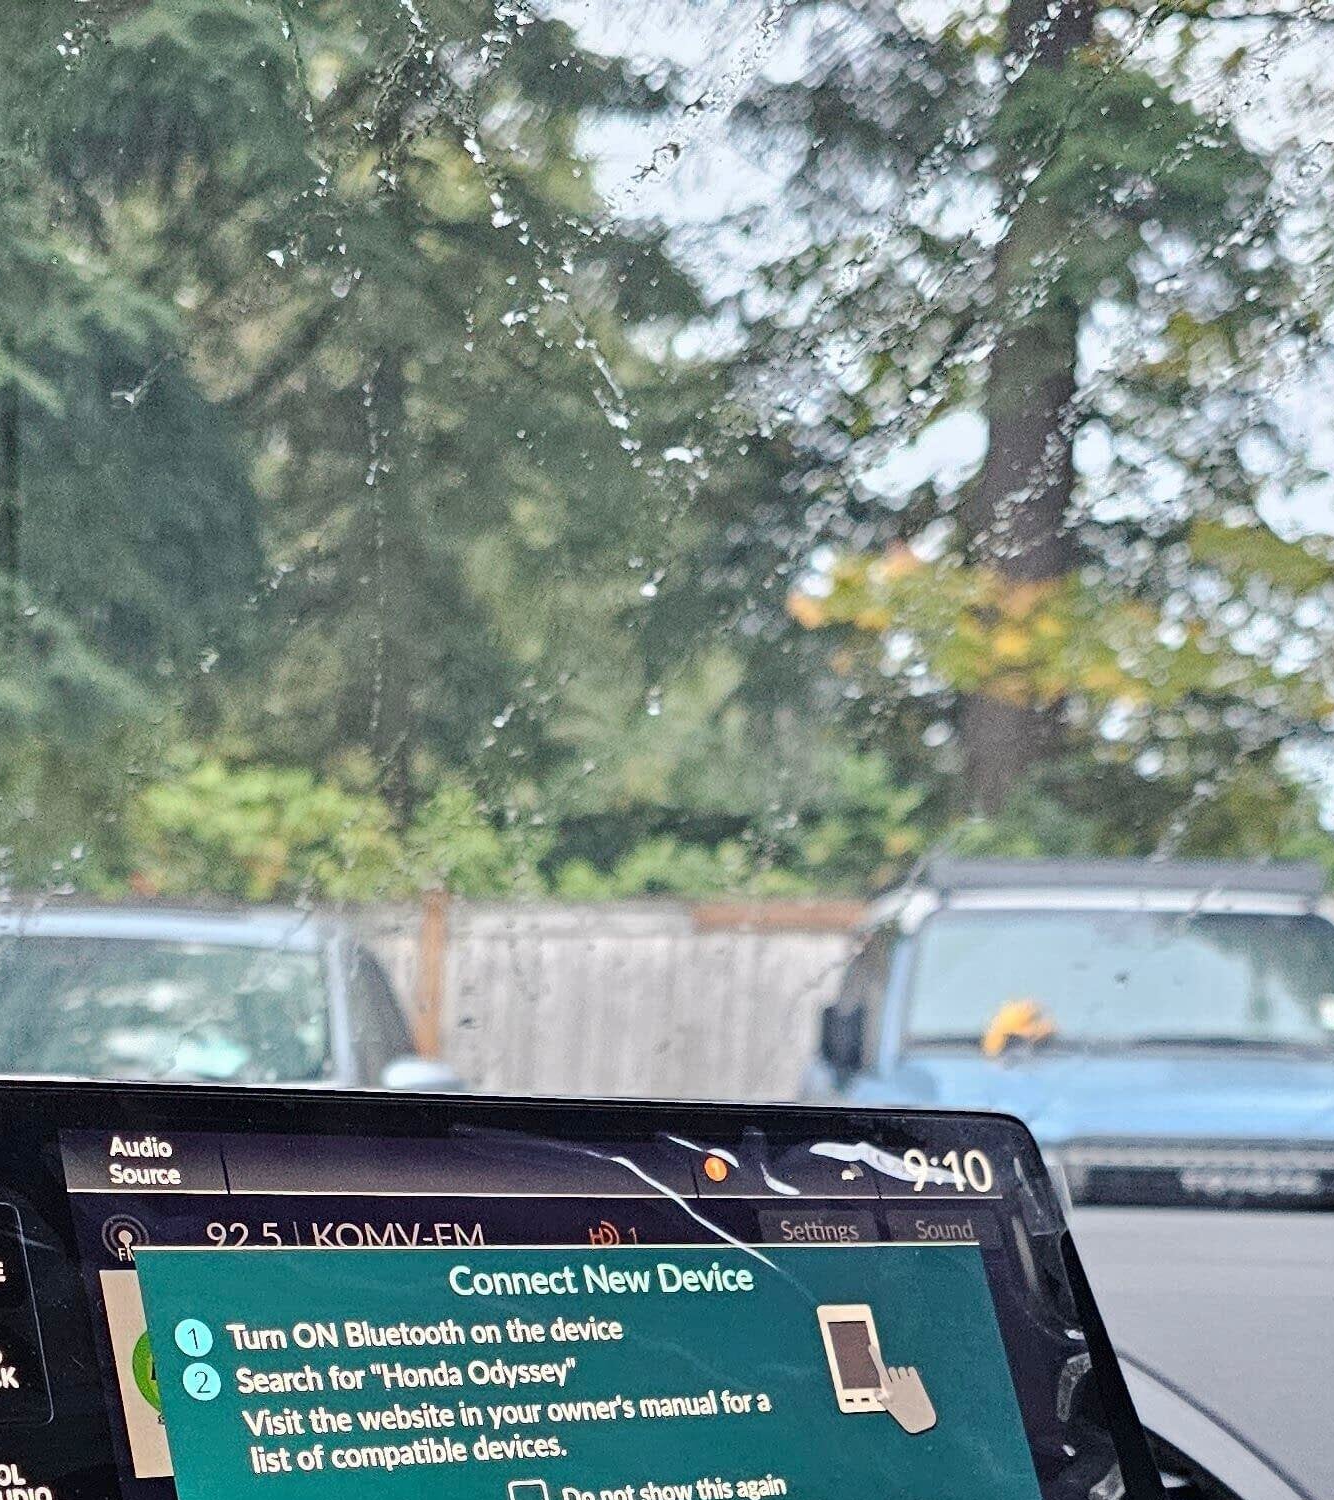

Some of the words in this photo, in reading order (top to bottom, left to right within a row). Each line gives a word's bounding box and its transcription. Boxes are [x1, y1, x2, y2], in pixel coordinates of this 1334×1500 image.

[109, 1136, 172, 1158] Audio
[109, 1164, 181, 1185] Source
[903, 1149, 992, 1192] 9:10
[207, 1222, 282, 1246] 925
[780, 1220, 859, 1243] Settings
[916, 1219, 974, 1241] Sound
[449, 1265, 578, 1296] Connect
[583, 1264, 649, 1294] New
[657, 1262, 754, 1292] Device
[226, 1323, 287, 1350] Turn
[293, 1322, 339, 1348] ON
[344, 1319, 466, 1348] Bluetooth
[470, 1324, 501, 1344] on
[506, 1318, 546, 1343] the
[550, 1316, 624, 1342] device
[194, 1371, 211, 1393] 2
[236, 1365, 323, 1394] Search
[328, 1365, 365, 1390] for
[370, 1360, 463, 1390] "Honda
[468, 1357, 576, 1388] Odyssey"
[242, 1408, 305, 1437] Visit
[309, 1407, 352, 1433] the
[357, 1402, 455, 1431] website
[458, 1400, 483, 1427] in
[486, 1403, 541, 1430] your
[547, 1394, 635, 1422] owner's
[639, 1390, 718, 1418] manual
[720, 1390, 752, 1414] for
[756, 1393, 773, 1412] a
[250, 1445, 292, 1474] list
[297, 1444, 324, 1471] of
[331, 1437, 467, 1471] compatible
[473, 1434, 568, 1461] devices.
[696, 1477, 733, 1500] this
[736, 1474, 787, 1500] again
